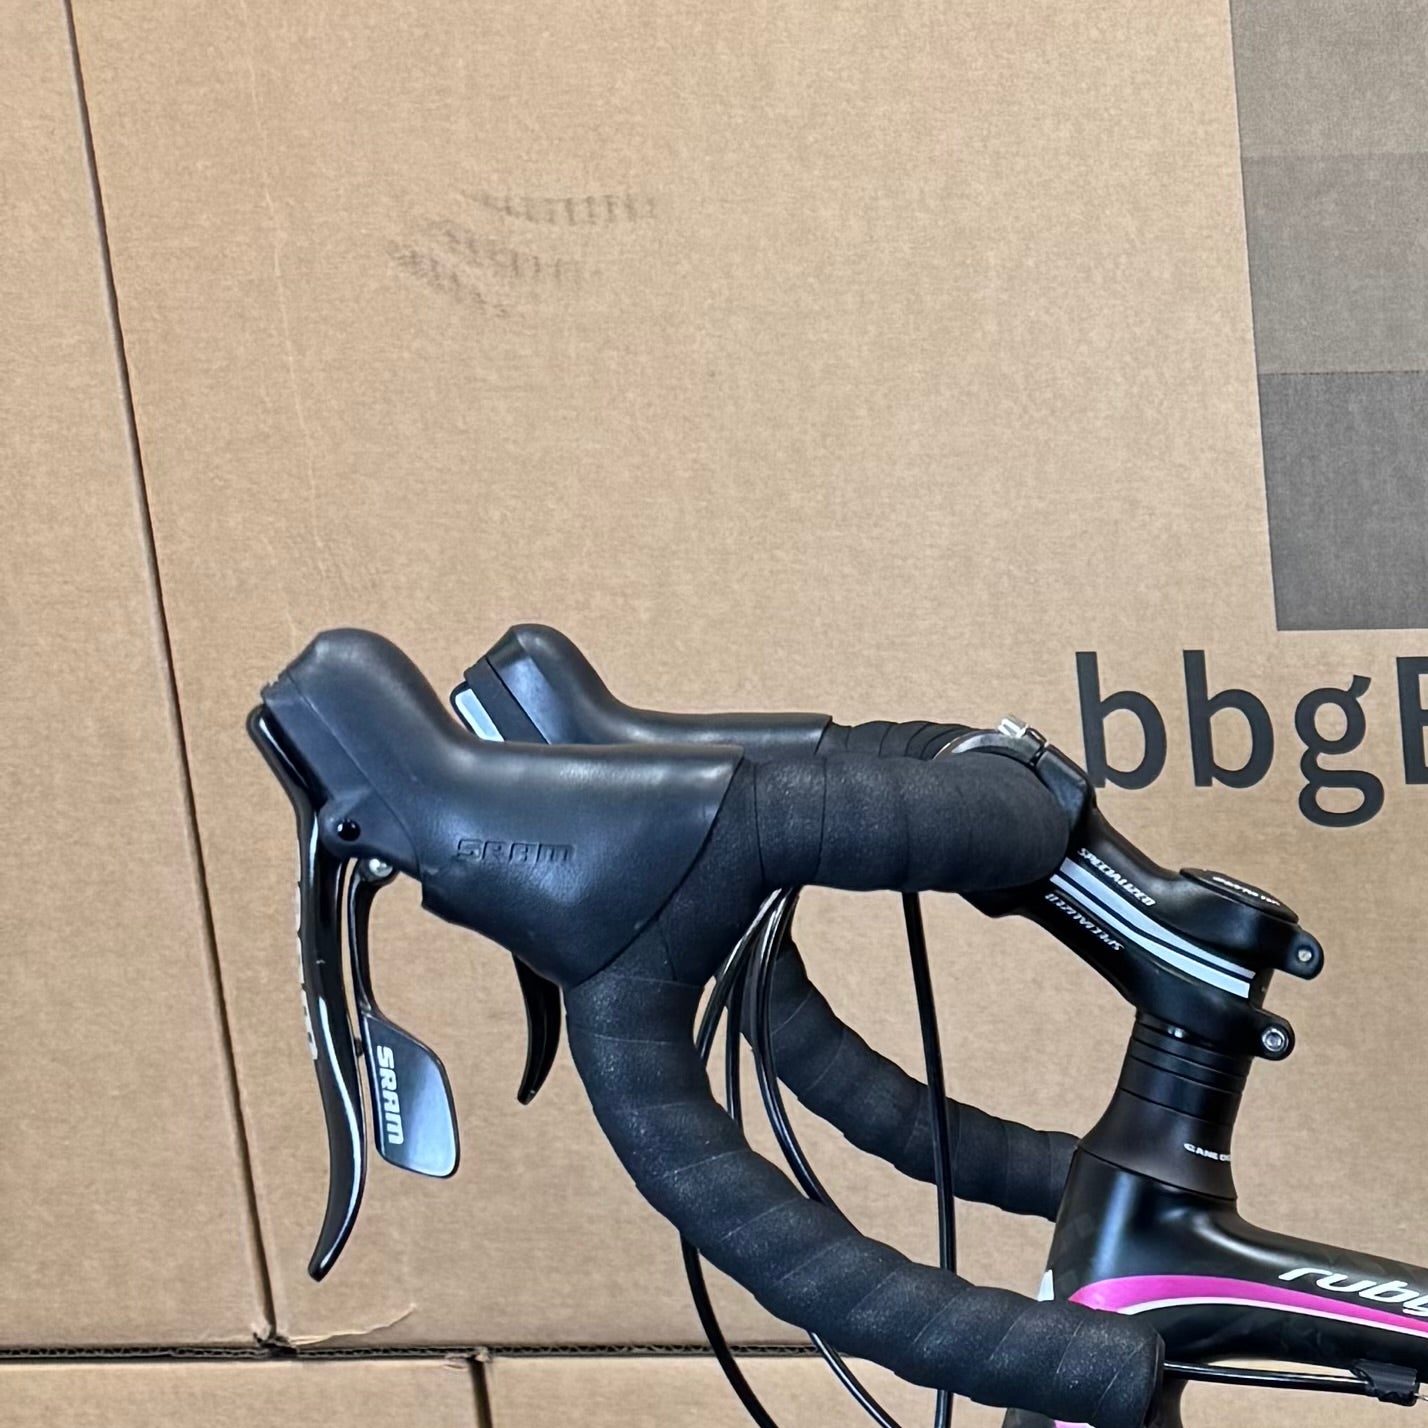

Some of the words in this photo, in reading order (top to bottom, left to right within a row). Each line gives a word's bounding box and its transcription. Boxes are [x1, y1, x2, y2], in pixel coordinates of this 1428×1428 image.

[457, 839, 577, 863] SRAM
[1077, 848, 1156, 907] SPECIALIZED
[1045, 893, 1126, 951] SPECIALIZED
[377, 1045, 404, 1145] SRAM
